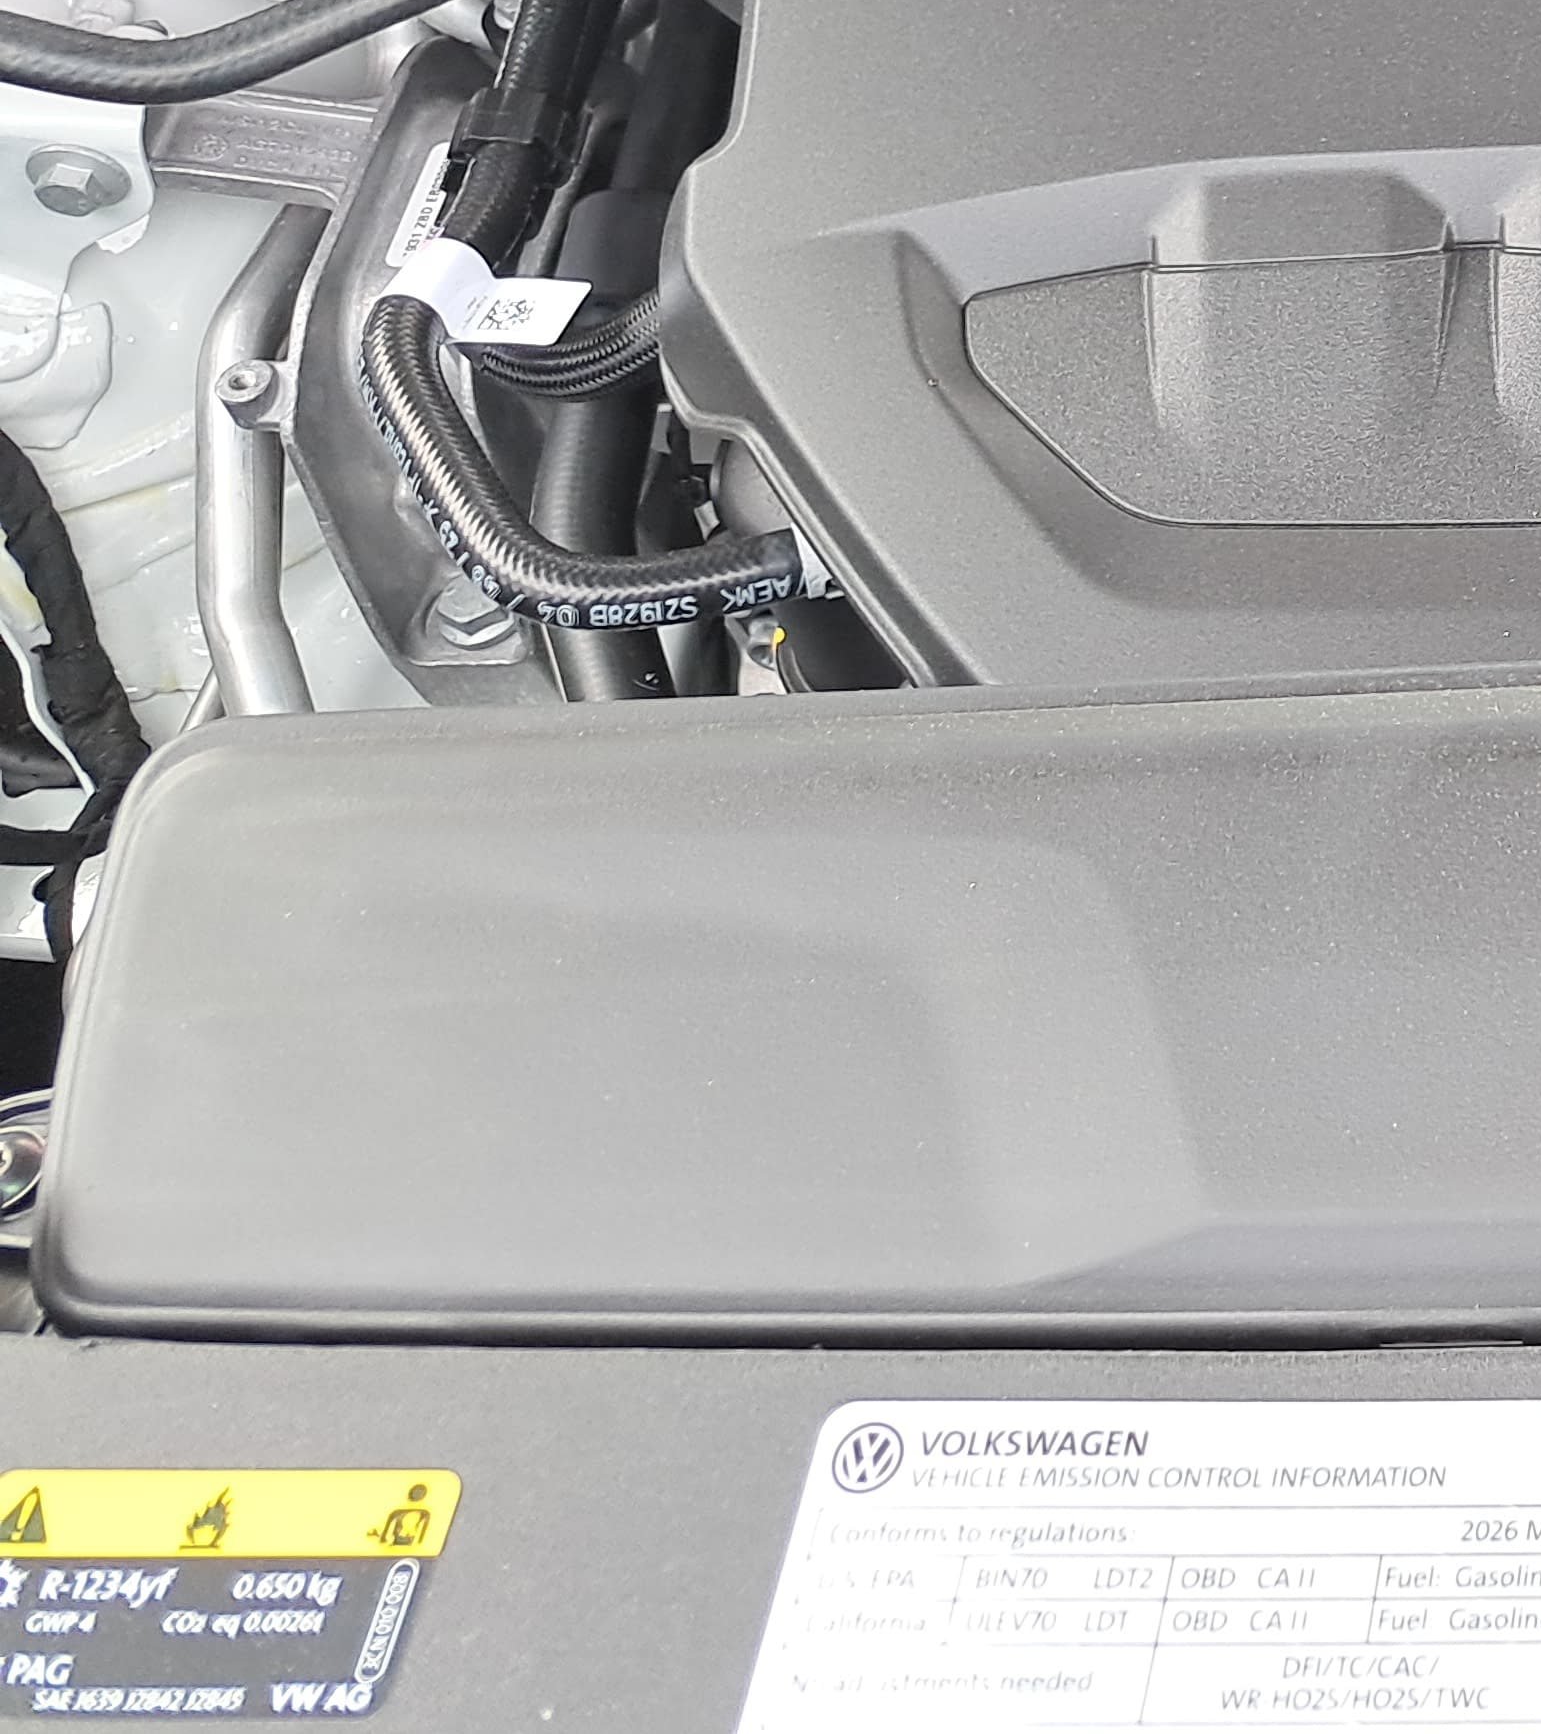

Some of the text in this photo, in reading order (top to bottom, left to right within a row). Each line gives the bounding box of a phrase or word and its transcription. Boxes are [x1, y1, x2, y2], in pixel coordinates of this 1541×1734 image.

[721, 573, 792, 610] AEMK
[921, 1429, 1150, 1457] VOLKSWAGEN
[912, 1466, 1447, 1488] VEHICLE EMISSION CONTROL INFORMATION
[957, 1523, 982, 1544] to
[1460, 1519, 1519, 1542] 2026
[38, 1567, 342, 1609] R-1234yf 0.650 kg
[975, 1567, 1049, 1589] BIN70
[1092, 1567, 1154, 1589] LDT2
[1257, 1567, 1290, 1589] CA
[211, 1614, 241, 1640] eq
[1249, 1610, 1282, 1632] CA
[6, 1653, 77, 1687] PAG
[31, 1687, 76, 1712] SAE
[271, 1682, 328, 1713] VW
[322, 1682, 374, 1713] AG
